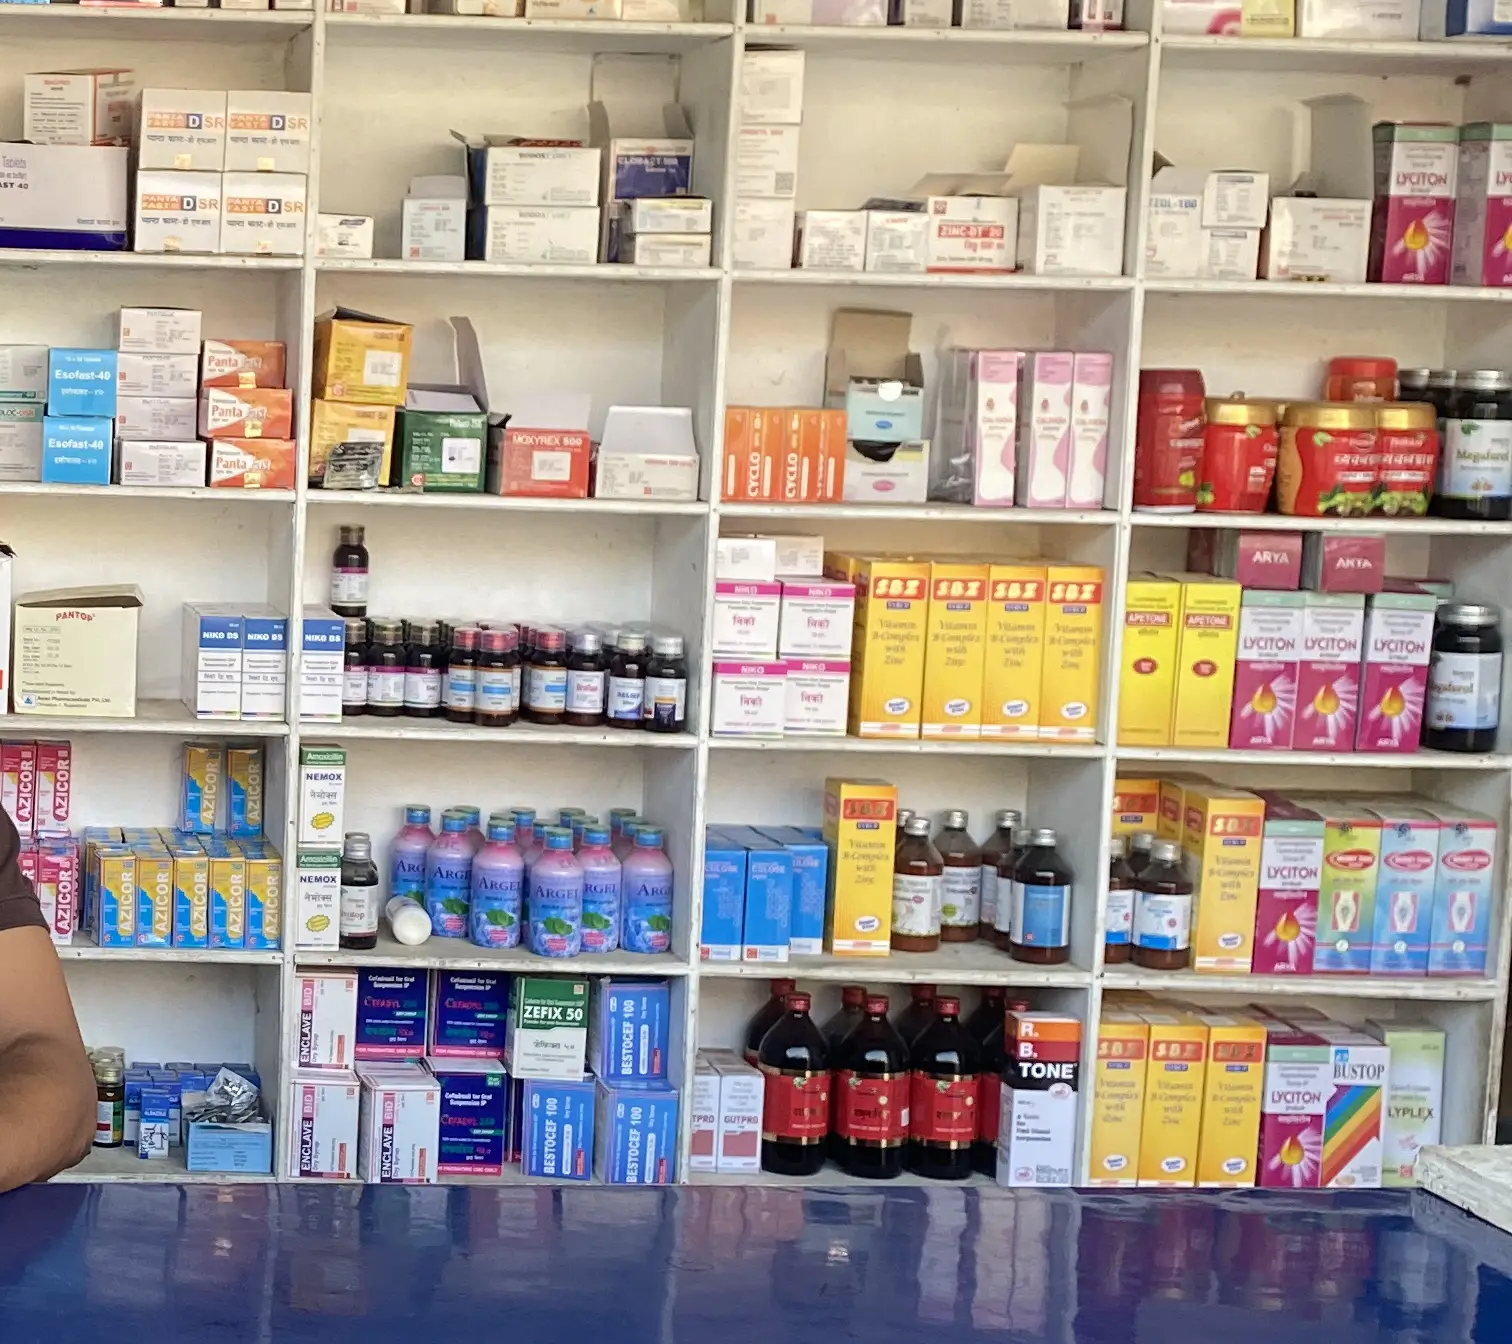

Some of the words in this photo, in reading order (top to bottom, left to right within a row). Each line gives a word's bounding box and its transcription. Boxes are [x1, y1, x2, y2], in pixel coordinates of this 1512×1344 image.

[189, 116, 200, 128] D
[205, 116, 224, 128] SR
[272, 117, 284, 129] D
[288, 117, 308, 129] SR
[17, 181, 29, 189] 40
[183, 198, 194, 209] D
[199, 199, 219, 210] SR
[268, 201, 280, 212] D
[285, 201, 304, 212] SR
[208, 356, 238, 368] Panta
[55, 370, 111, 381] Esofast-40
[212, 405, 242, 417] Panta
[49, 438, 104, 449] Esofast-40
[216, 458, 246, 469] Panta
[1252, 550, 1289, 564] ARYA
[56, 612, 93, 622] PANTOP
[203, 631, 224, 639] NIKO
[248, 633, 269, 641] NIKO
[305, 634, 326, 642] NIKO
[1243, 636, 1295, 651] LYCITON
[1305, 636, 1357, 651] LYCITON
[1374, 639, 1425, 654] LYCITON
[306, 773, 342, 782] NEMOX
[56, 757, 69, 818] AZICOR
[300, 875, 337, 884] NEMOX
[1268, 866, 1318, 881] LYCITON
[535, 884, 580, 898] ARGEL
[121, 871, 133, 933] AZICOR
[155, 871, 168, 934] AZICOR
[193, 872, 206, 934] AZICOR
[229, 873, 242, 935] AZICOR
[303, 986, 313, 1006] BID
[524, 1006, 563, 1020] ZEFIX
[566, 1007, 584, 1021] 50
[623, 999, 634, 1015] 100
[300, 1009, 312, 1063] ENCLAVE
[1021, 1022, 1039, 1037] R.
[621, 1016, 633, 1075] BESTOCEF
[1019, 1042, 1038, 1058] B.
[1019, 1062, 1074, 1080] TONE
[1333, 1062, 1385, 1081] BUSTOP
[303, 1093, 314, 1114] BID
[1271, 1089, 1321, 1104] LYCITON
[384, 1100, 394, 1121] BID
[546, 1097, 558, 1114] 100
[630, 1106, 643, 1123] 100
[301, 1118, 313, 1172] ENCLAVE
[381, 1125, 394, 1179] ENCLAVE
[543, 1116, 557, 1175] BESTOCEF
[626, 1125, 639, 1184] BESTOCEF
